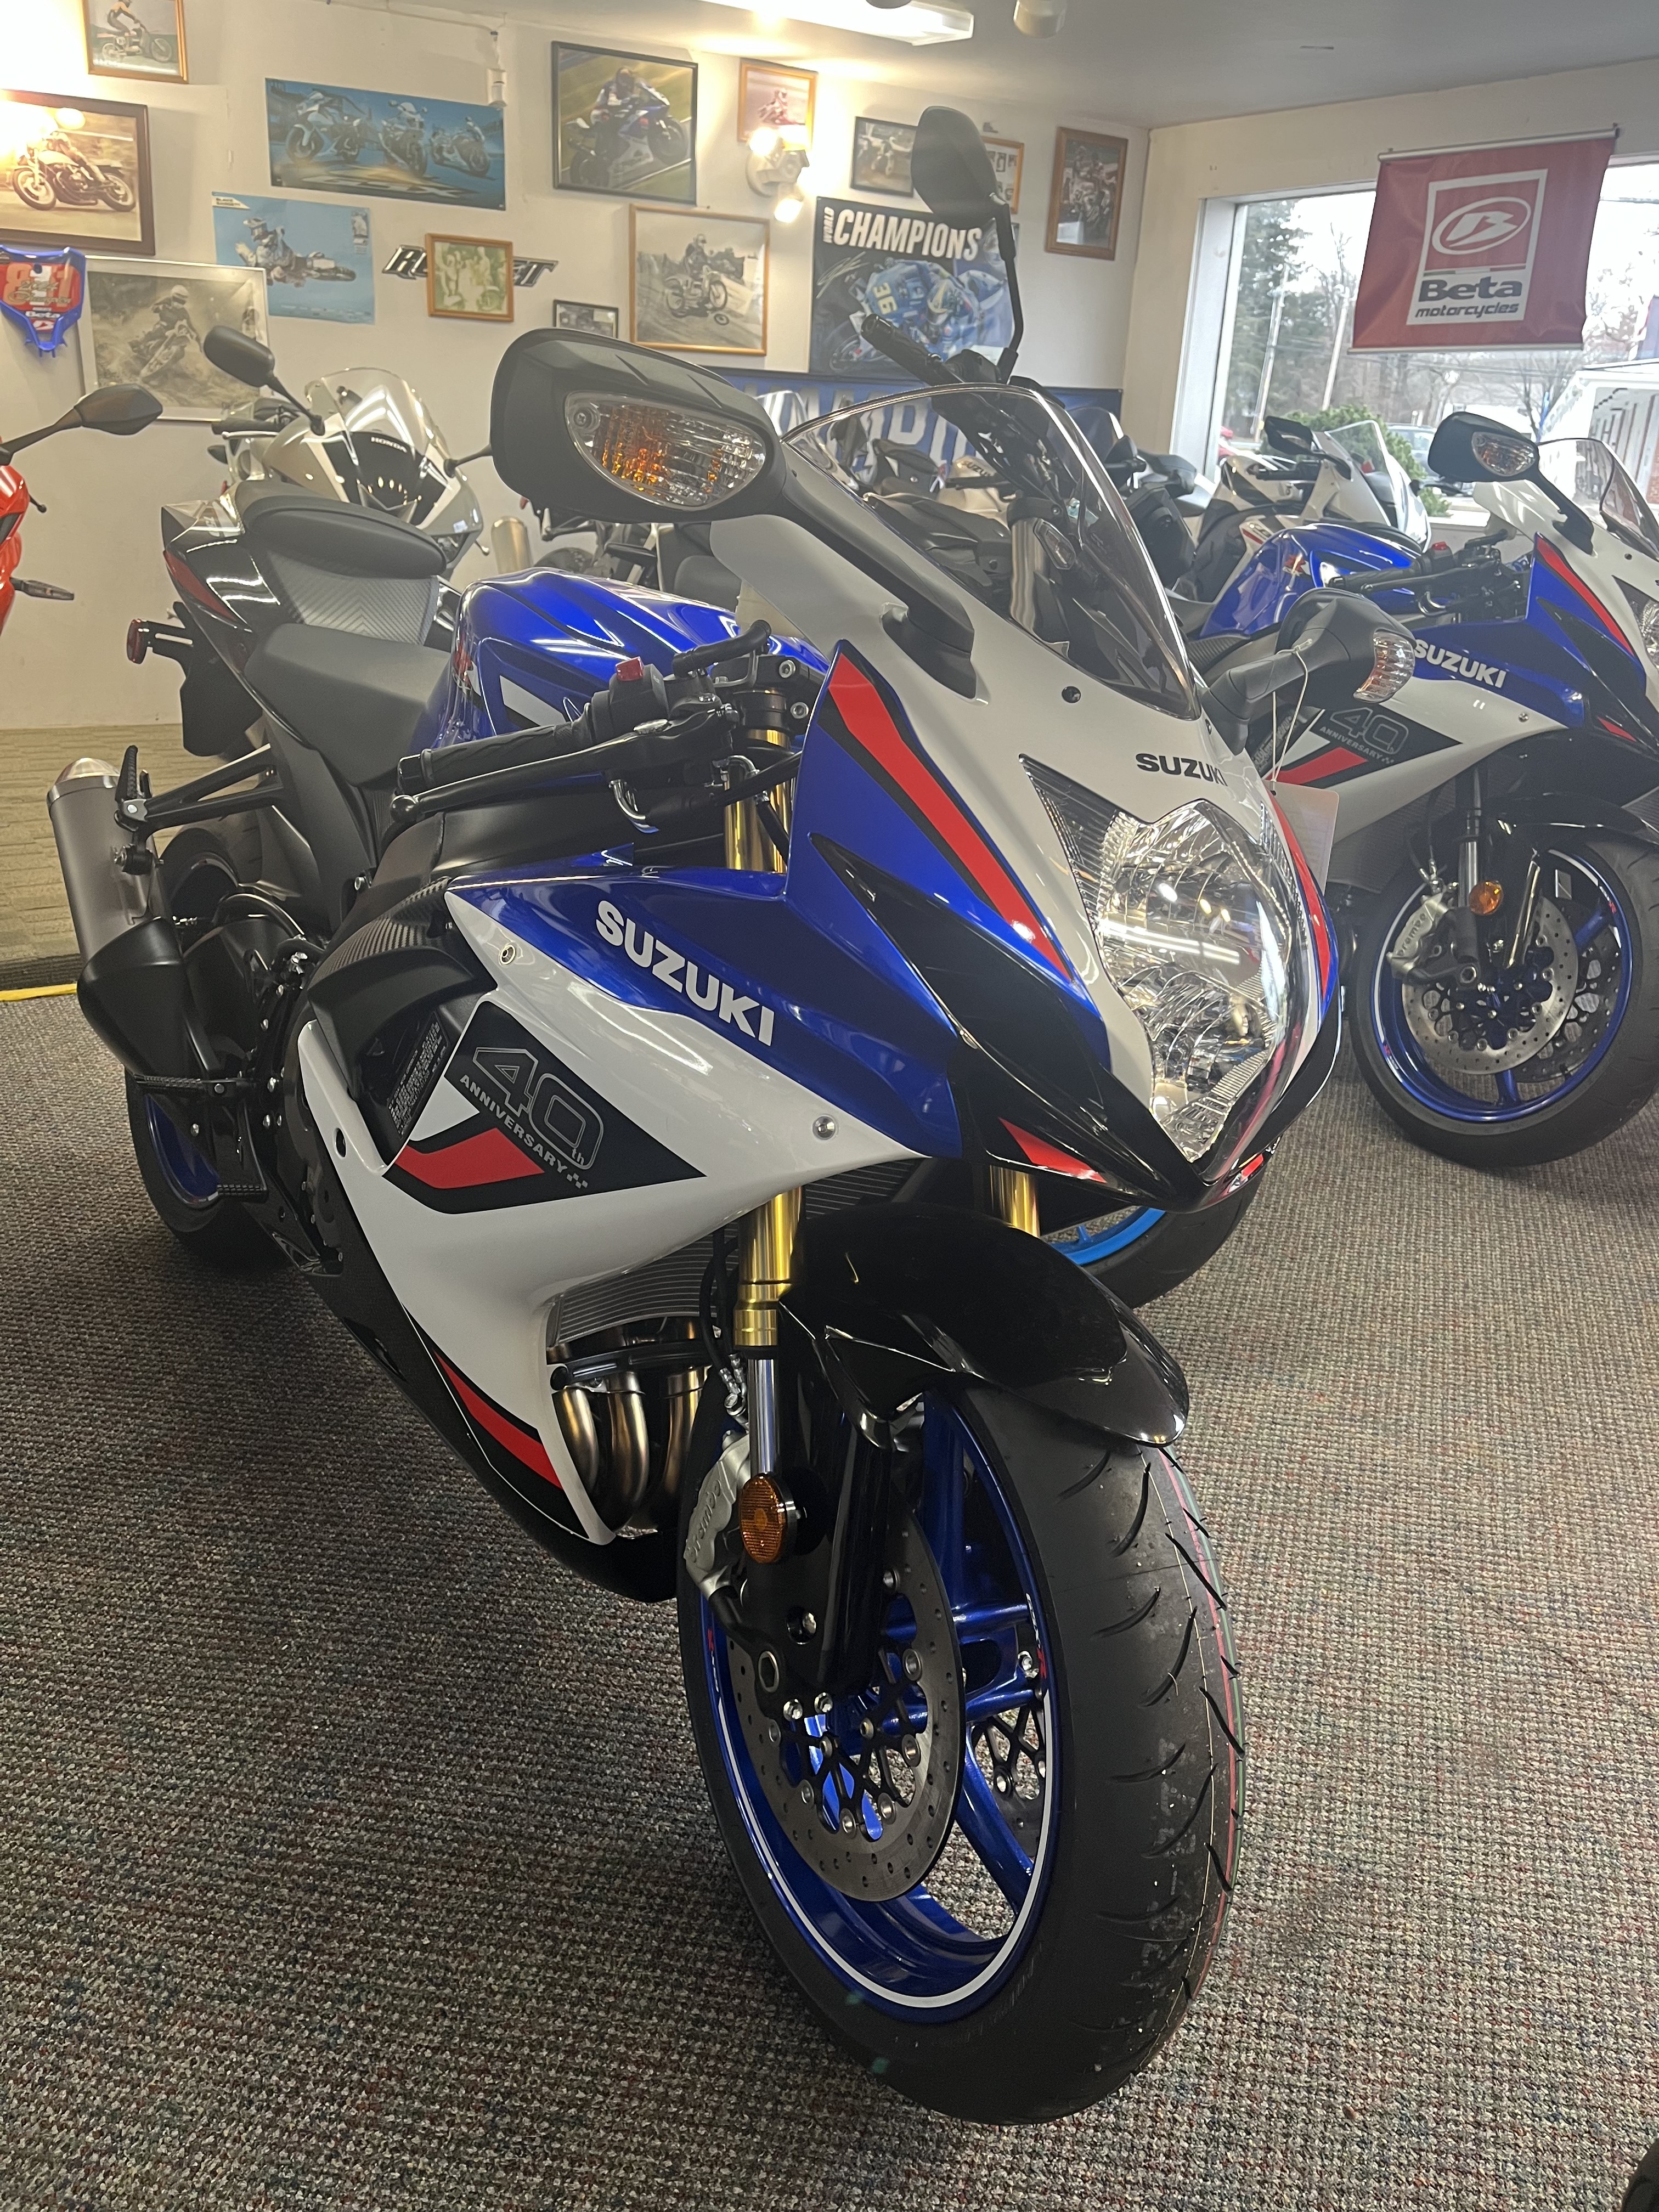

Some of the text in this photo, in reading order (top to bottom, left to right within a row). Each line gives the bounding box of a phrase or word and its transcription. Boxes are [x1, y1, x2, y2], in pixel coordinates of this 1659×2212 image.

[823, 206, 983, 261] WORLD CHAMPIONS
[872, 282, 898, 315] 36
[1418, 276, 1522, 302] Beta
[1415, 302, 1519, 318] motorcycles
[371, 437, 407, 453] HONDA
[1414, 639, 1506, 688] SUZUKI
[1319, 726, 1383, 759] ANNIVERSARY
[1136, 753, 1228, 786] SUZUKI
[1395, 913, 1426, 956] brembo
[596, 900, 775, 1047] SUZUKI
[460, 1075, 568, 1173] ANNIVERSARY
